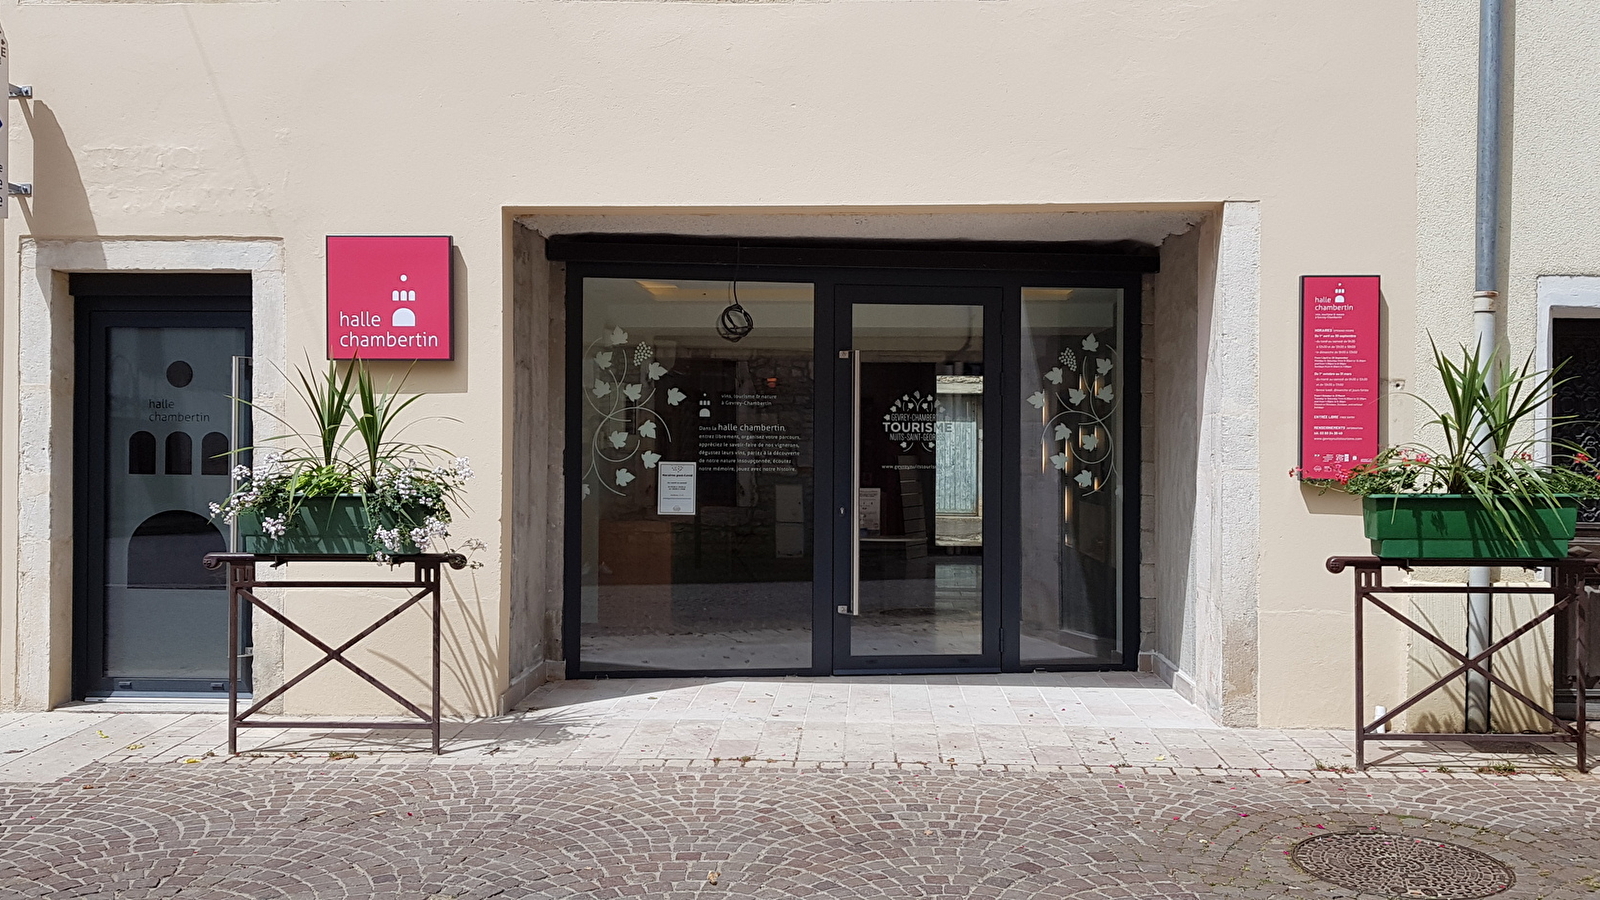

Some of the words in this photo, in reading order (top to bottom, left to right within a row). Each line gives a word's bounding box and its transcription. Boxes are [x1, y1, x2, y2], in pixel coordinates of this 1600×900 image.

[339, 311, 381, 327] halle
[339, 331, 438, 347] chambertin
[148, 399, 175, 409] halle
[148, 411, 210, 422] chambertin
[717, 423, 738, 431] halle
[882, 422, 953, 433] TOURISME
